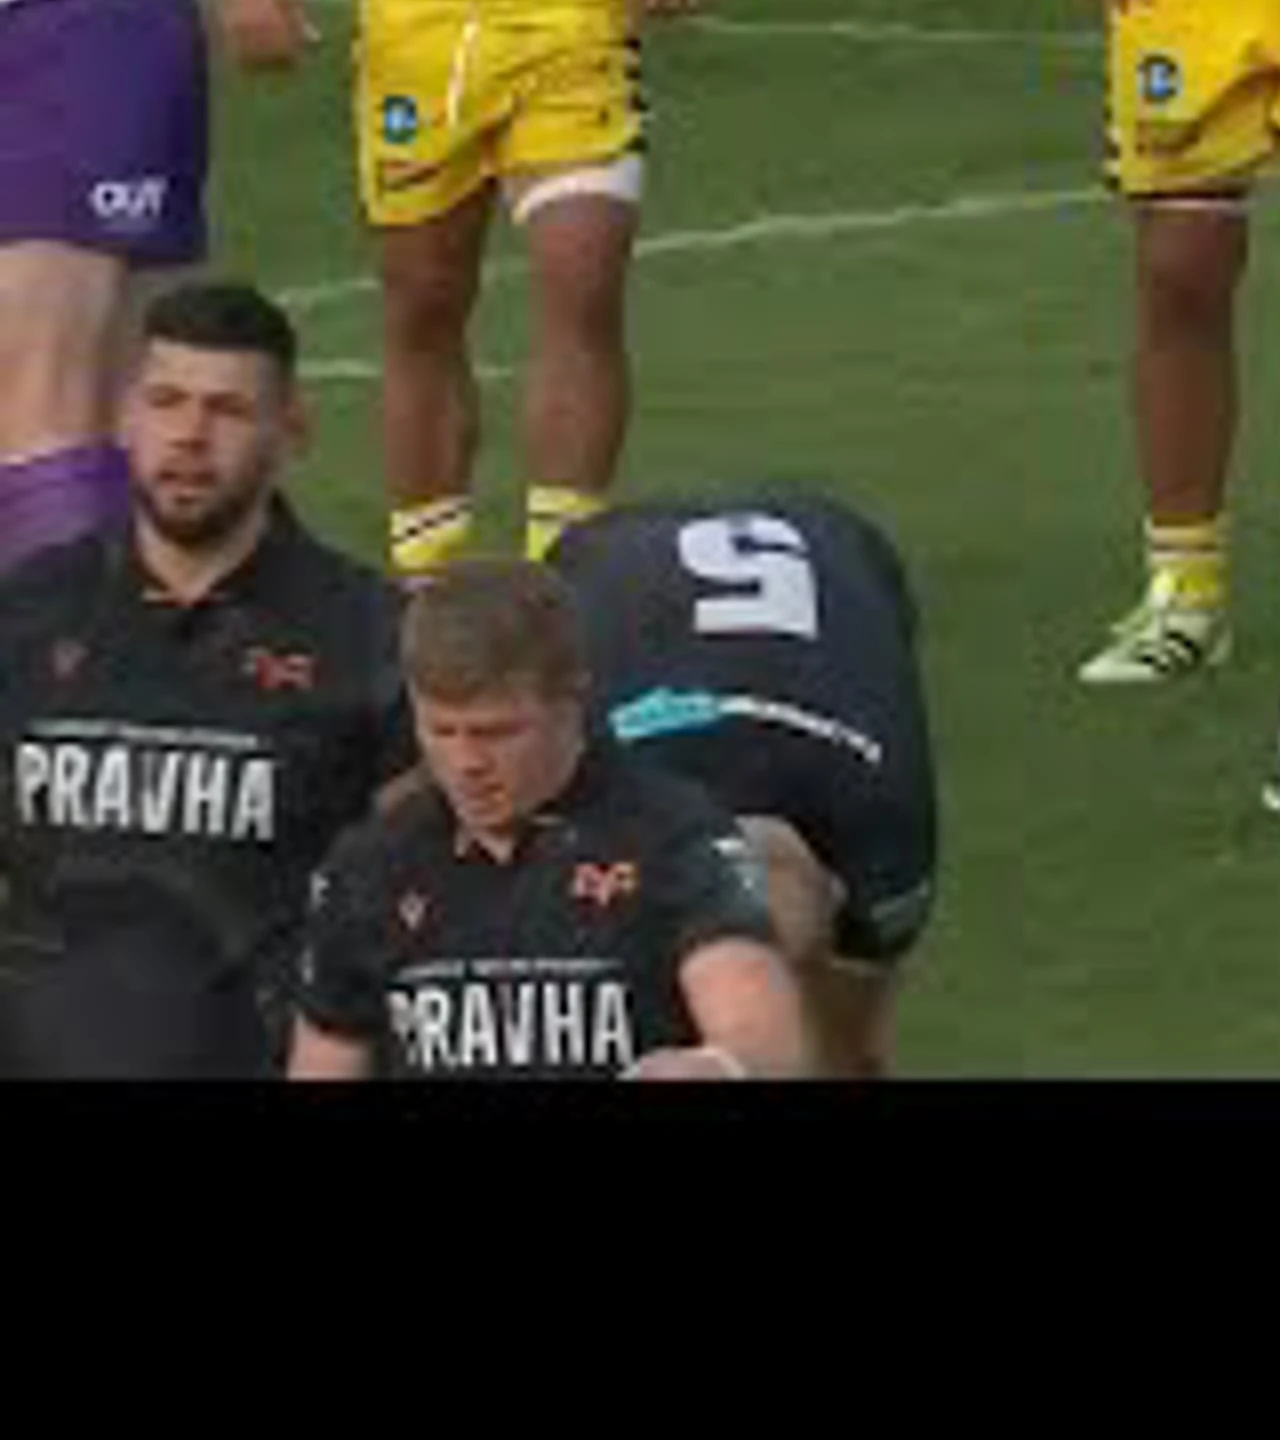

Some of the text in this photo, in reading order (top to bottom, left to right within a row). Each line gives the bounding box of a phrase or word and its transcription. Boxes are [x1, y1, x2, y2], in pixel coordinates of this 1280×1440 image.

[91, 176, 169, 220] OUT
[15, 742, 275, 833] PRAVHA
[387, 982, 636, 1072] PRAVHA
